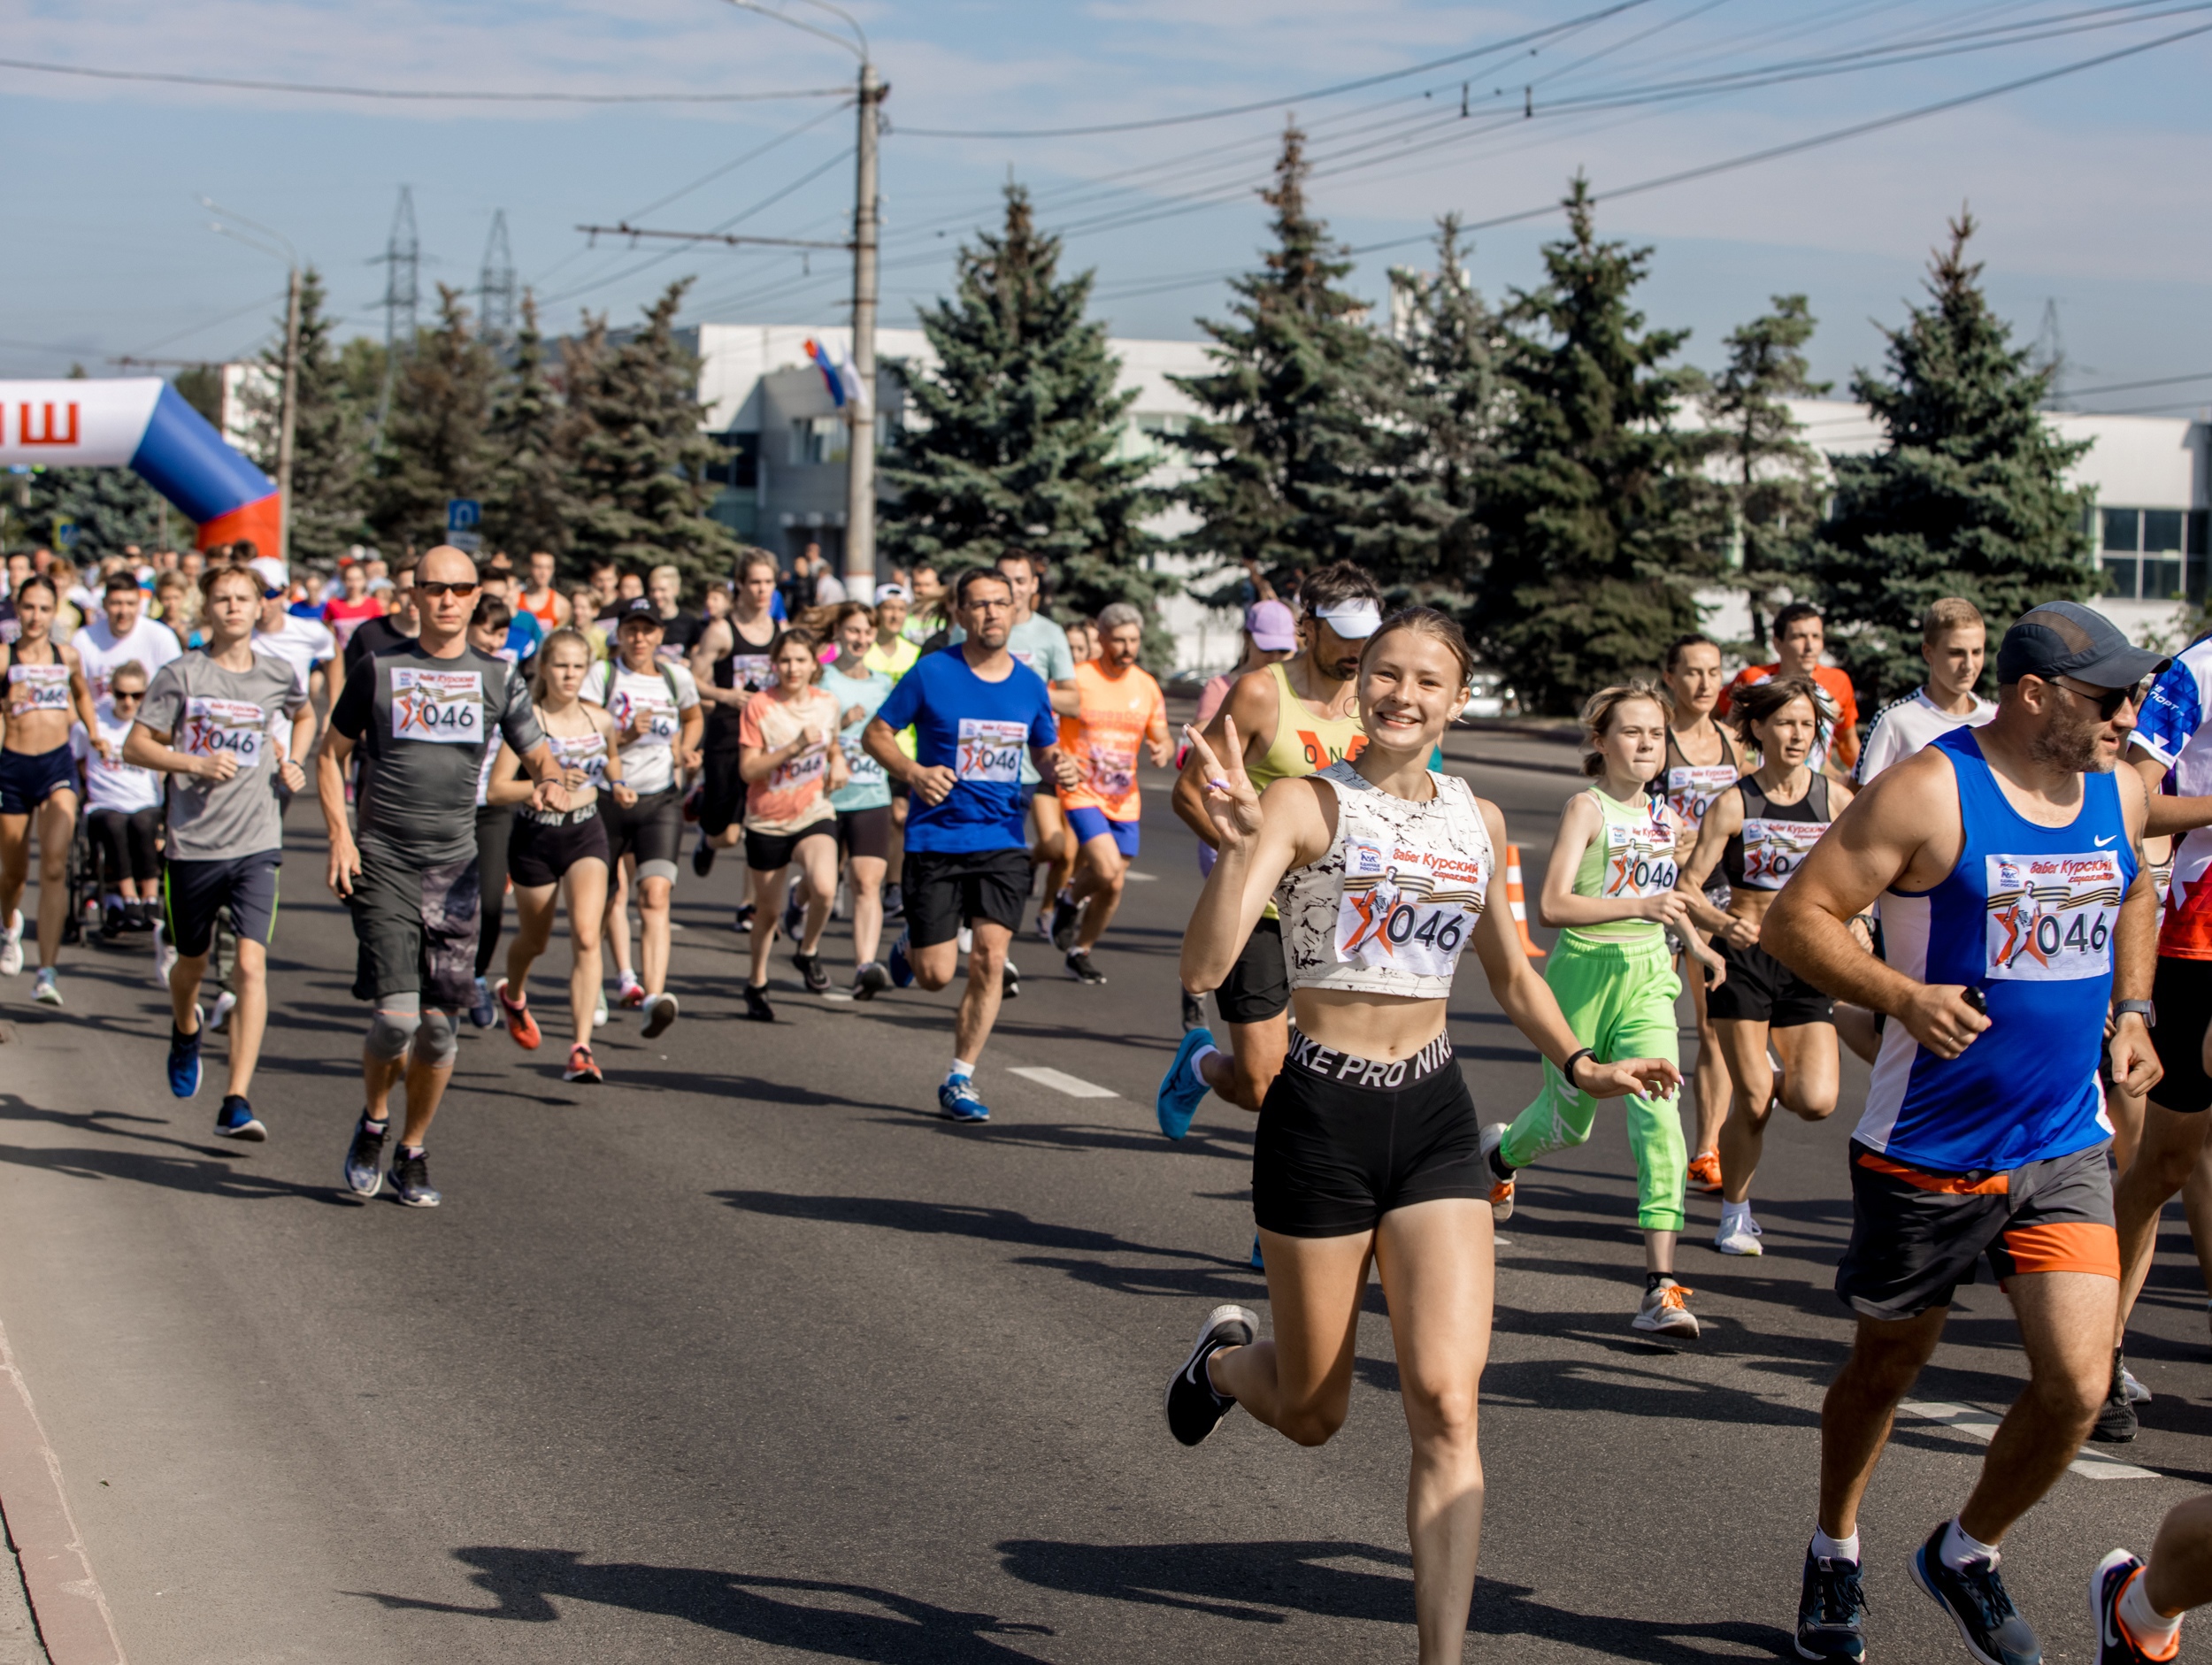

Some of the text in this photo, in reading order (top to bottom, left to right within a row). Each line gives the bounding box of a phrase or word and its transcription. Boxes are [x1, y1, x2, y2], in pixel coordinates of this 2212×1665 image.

[0, 403, 79, 445] Ш
[2149, 691, 2180, 710] ПОРТ
[424, 703, 474, 727] 046
[209, 730, 255, 754] 046
[850, 756, 881, 775] 046
[981, 749, 1018, 771] 046
[1304, 744, 1343, 765] ON
[1393, 848, 1479, 876] Забег Курский
[2030, 859, 2113, 877] Забег Курский
[1633, 860, 1674, 890] 046
[1386, 903, 1466, 953] 046
[2036, 910, 2108, 955] 046
[1336, 1055, 1408, 1088] PRO
